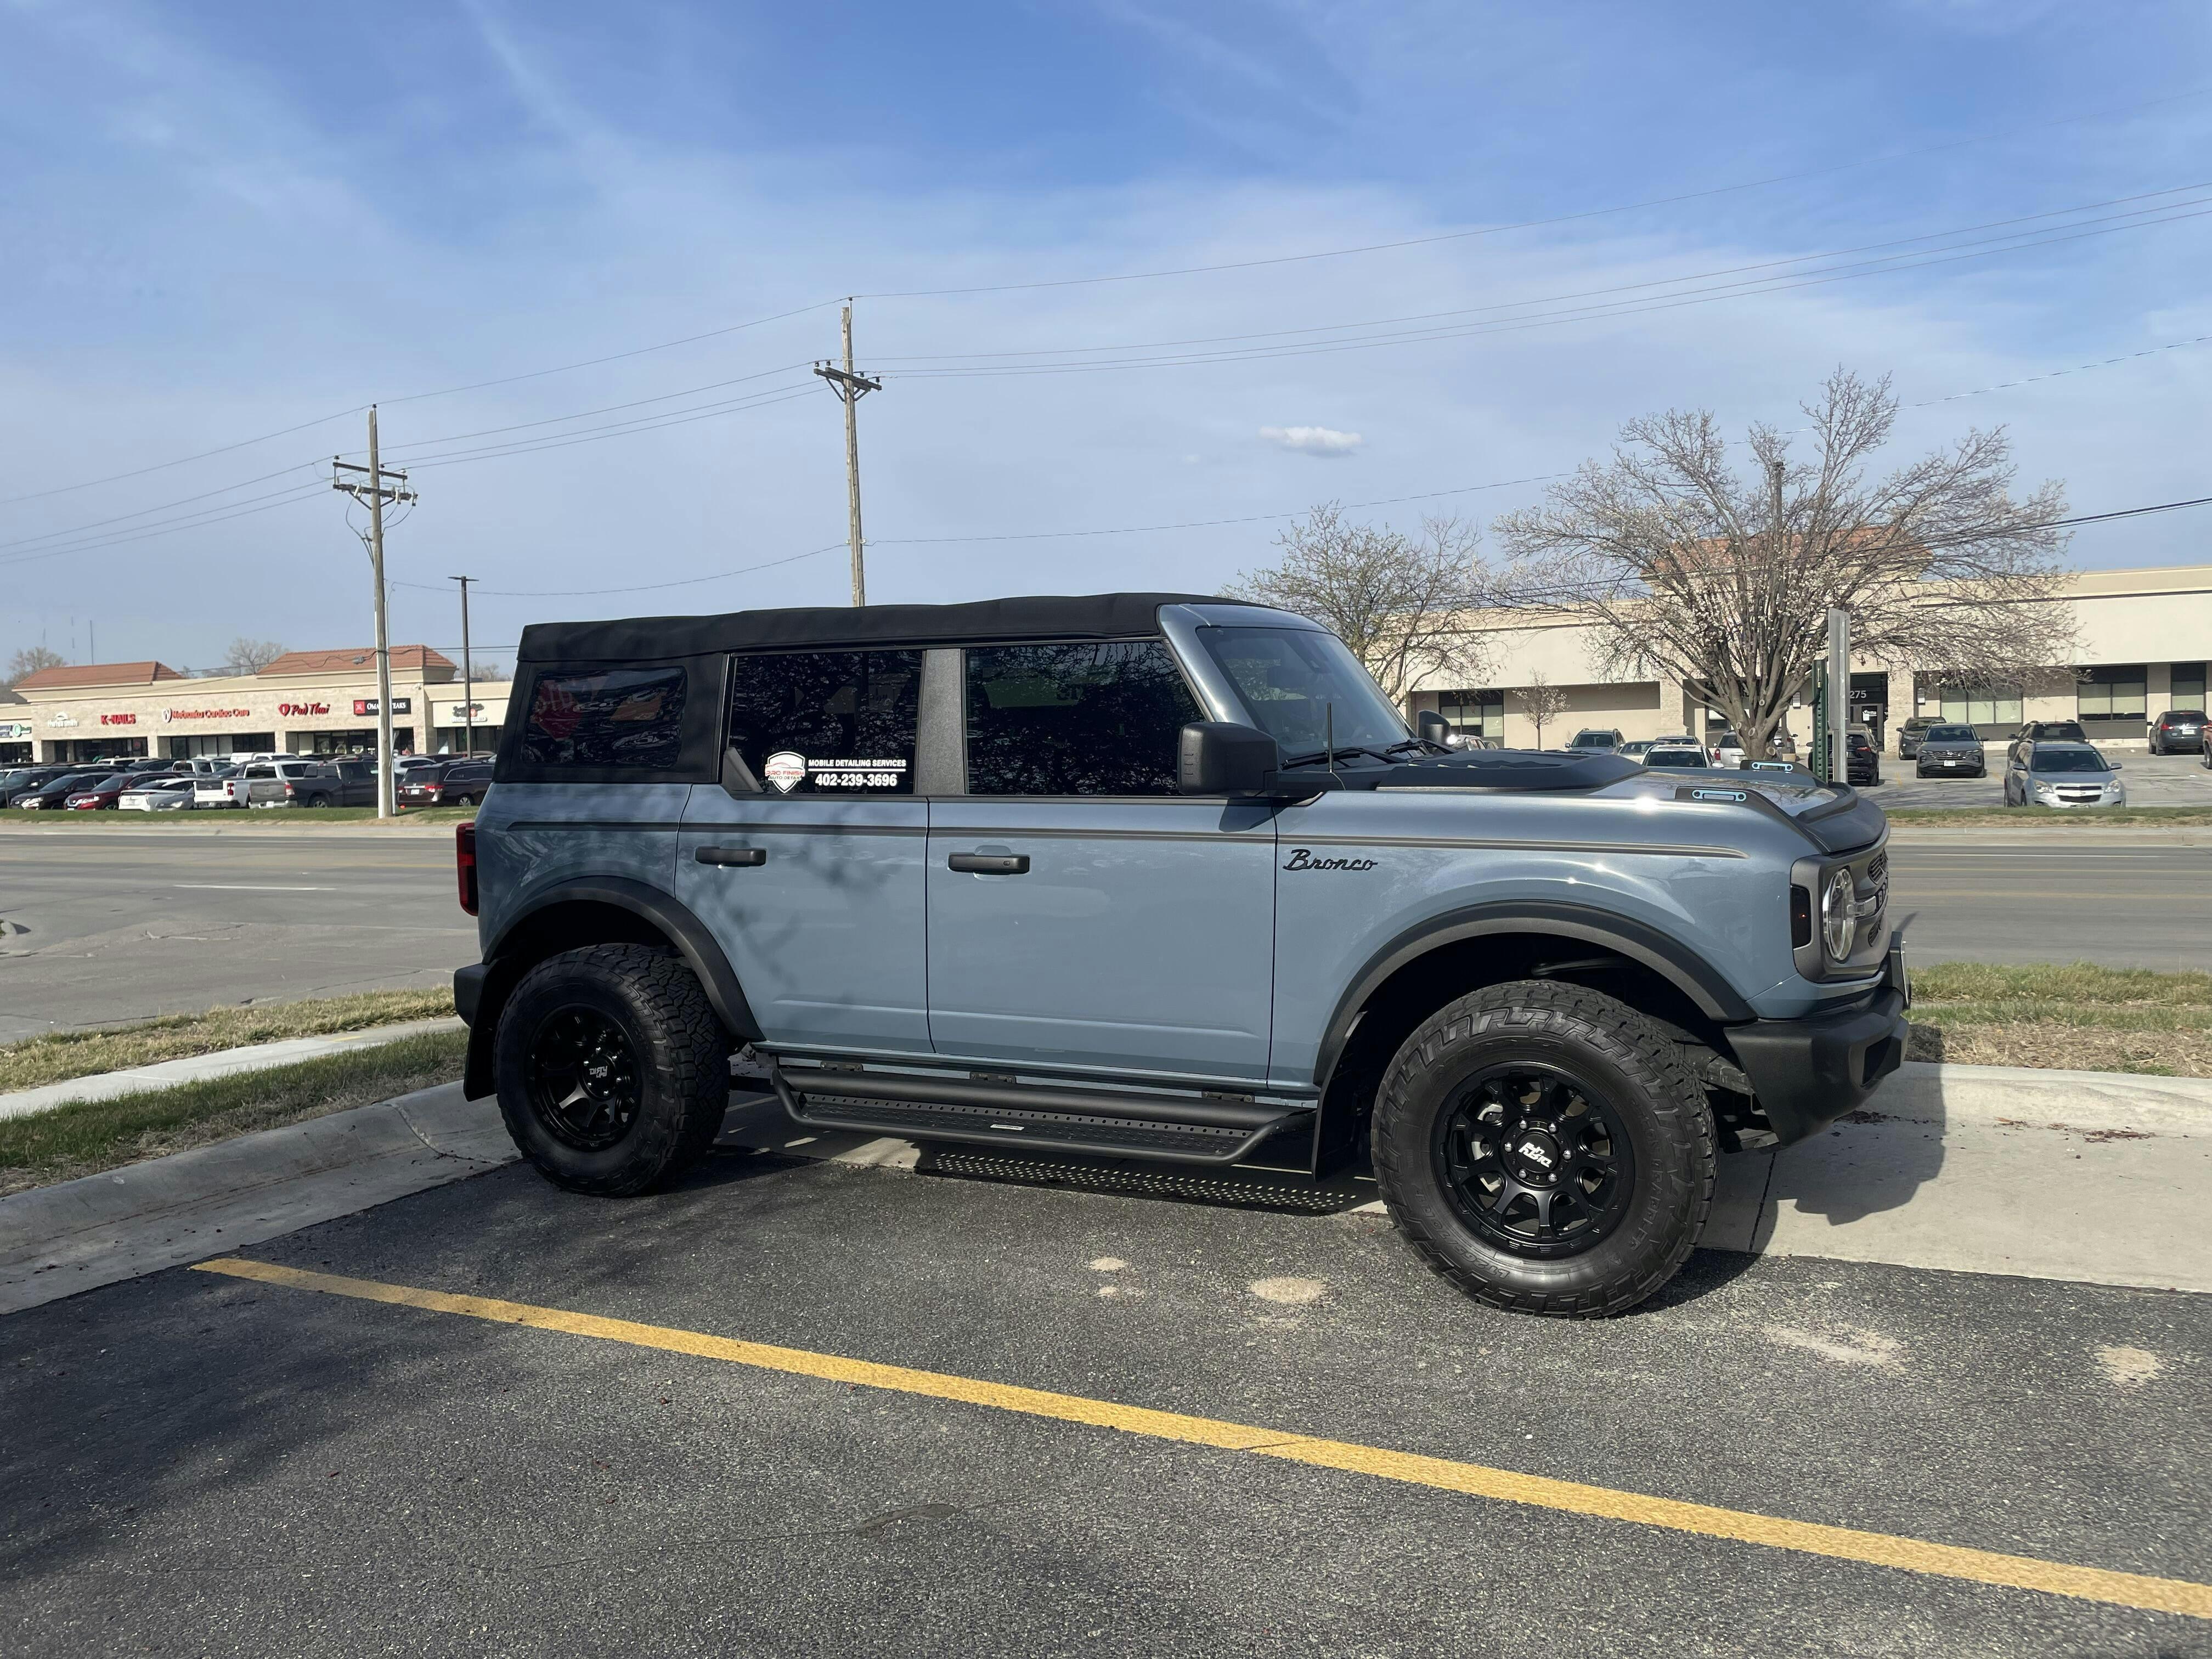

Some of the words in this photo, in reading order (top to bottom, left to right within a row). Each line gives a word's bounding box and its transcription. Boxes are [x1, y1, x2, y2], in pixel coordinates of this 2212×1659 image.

[1849, 690, 1867, 699] 275
[291, 702, 308, 716] Pad
[309, 702, 330, 716] Thai
[367, 702, 380, 710] OMA
[100, 714, 136, 725] K-NAILS
[815, 774, 898, 787] 402-239-3696
[1282, 849, 1379, 871] Bronco
